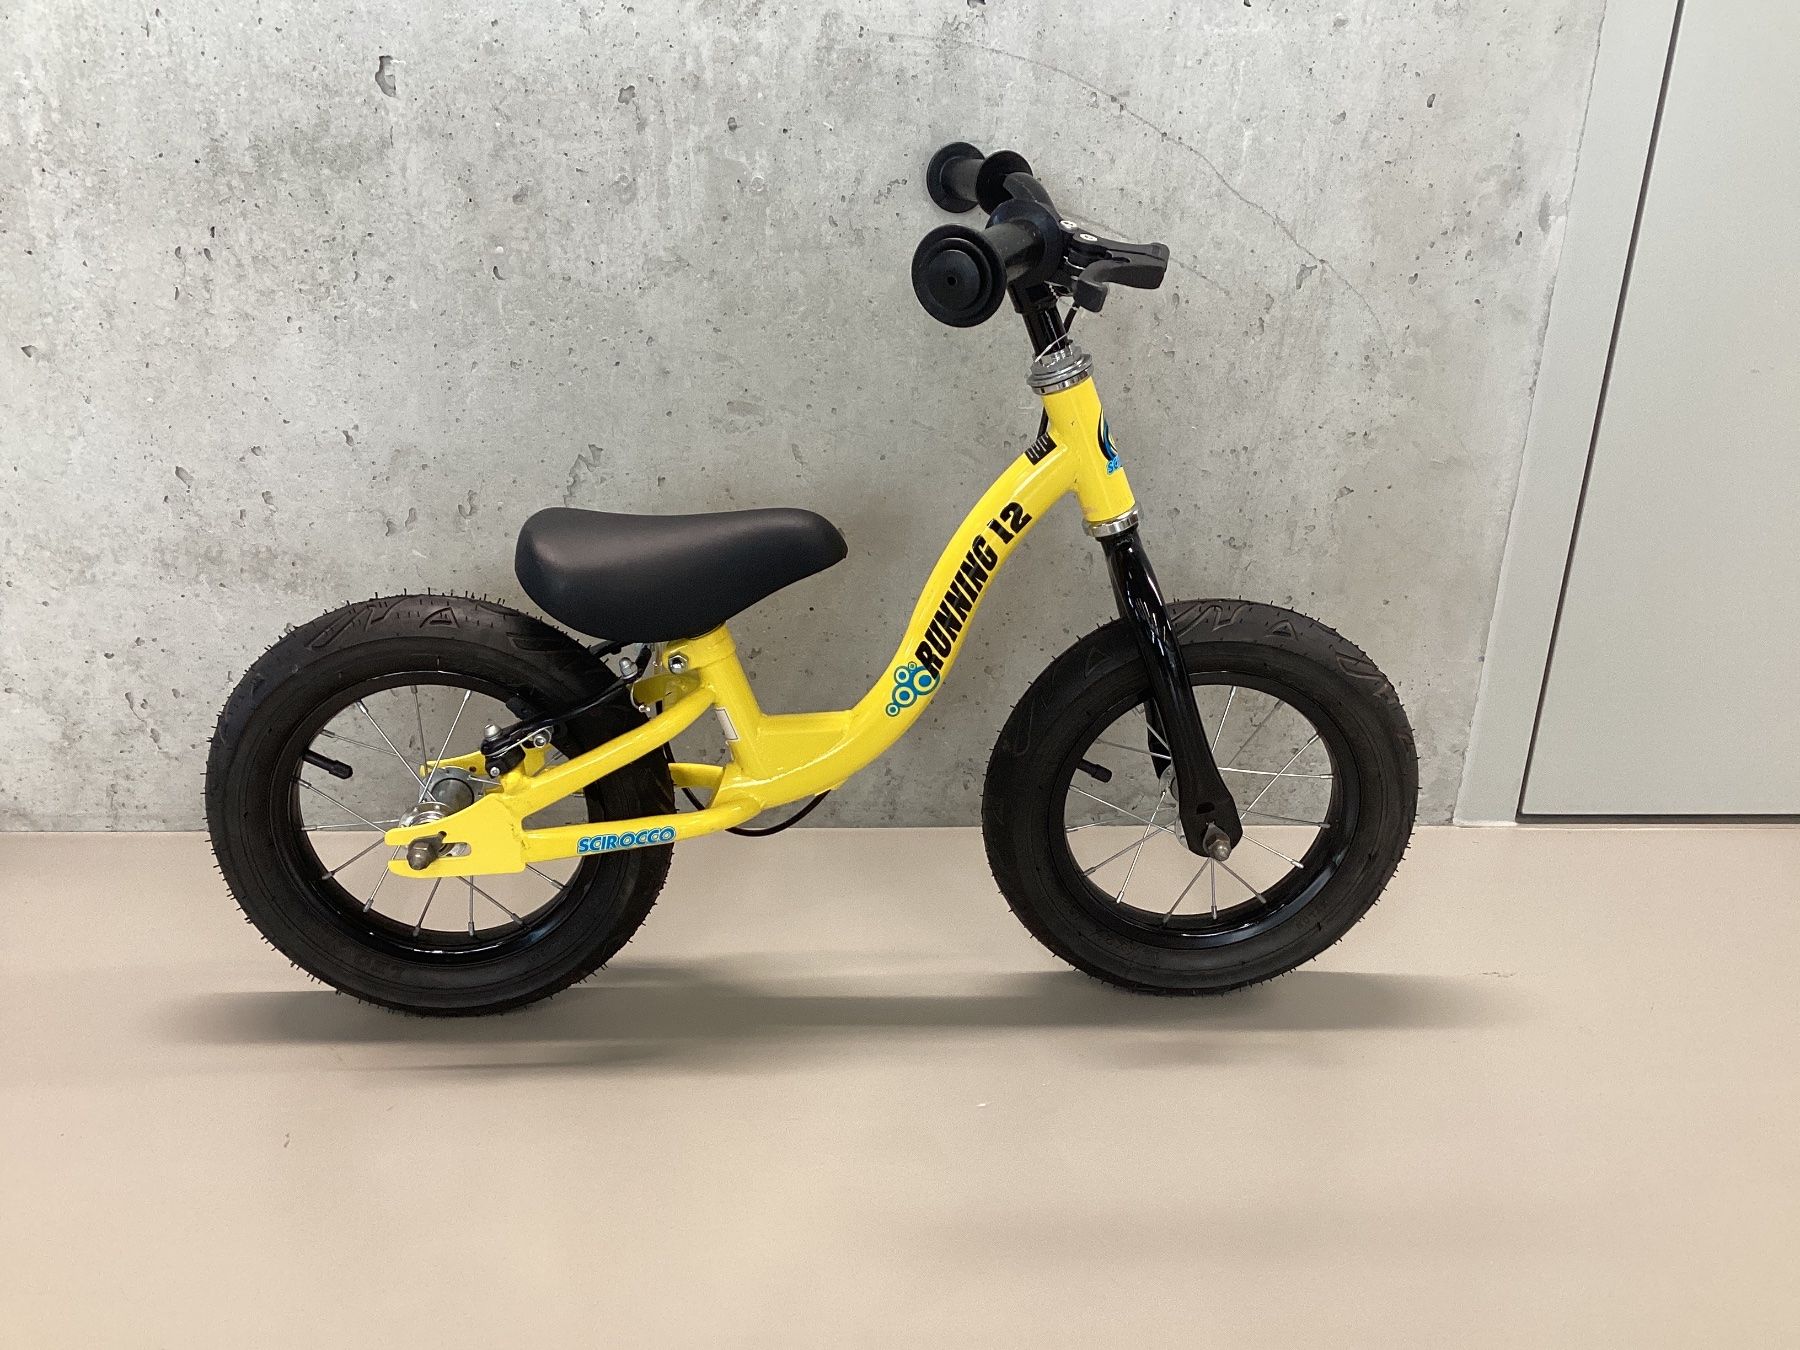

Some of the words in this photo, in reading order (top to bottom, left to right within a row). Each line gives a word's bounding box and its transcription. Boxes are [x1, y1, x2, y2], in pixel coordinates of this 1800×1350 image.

[915, 534, 998, 679] RUNNING
[987, 502, 1032, 544] 12
[577, 826, 675, 854] SCIROCCO
